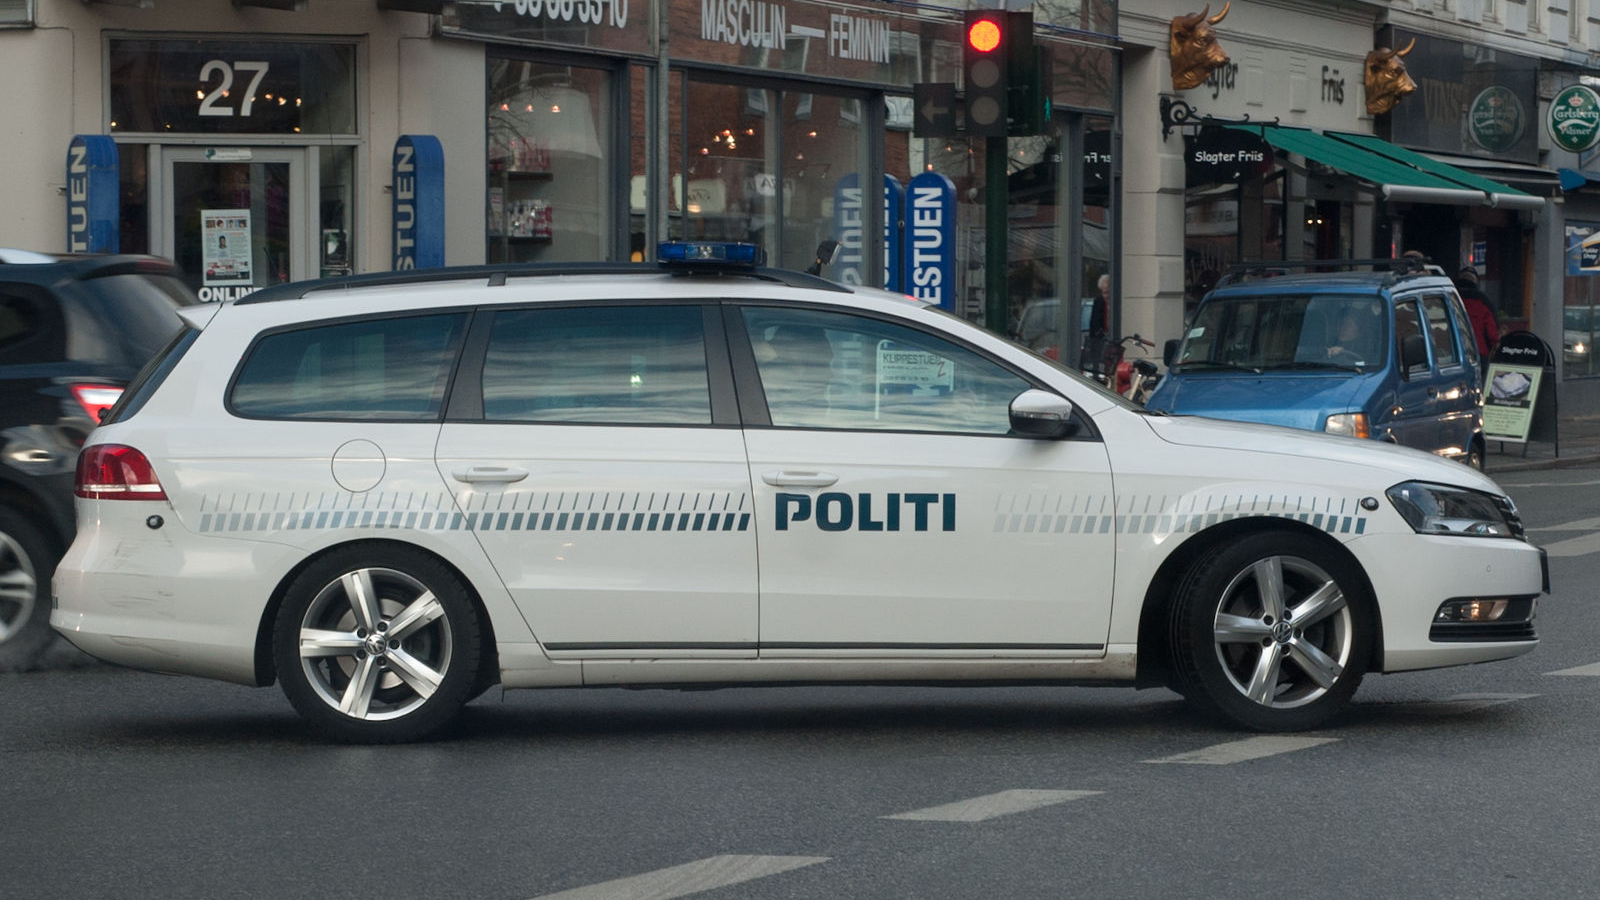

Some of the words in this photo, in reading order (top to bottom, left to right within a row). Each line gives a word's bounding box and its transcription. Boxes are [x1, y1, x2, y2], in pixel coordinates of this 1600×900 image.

[701, 0, 786, 50] MASCULIN
[198, 60, 270, 117] 27
[1553, 104, 1600, 124] Carlsberg
[1195, 151, 1236, 165] Slagter
[1238, 150, 1264, 162] Friis
[198, 286, 264, 303] ONLIN
[775, 492, 956, 531] POLITI
